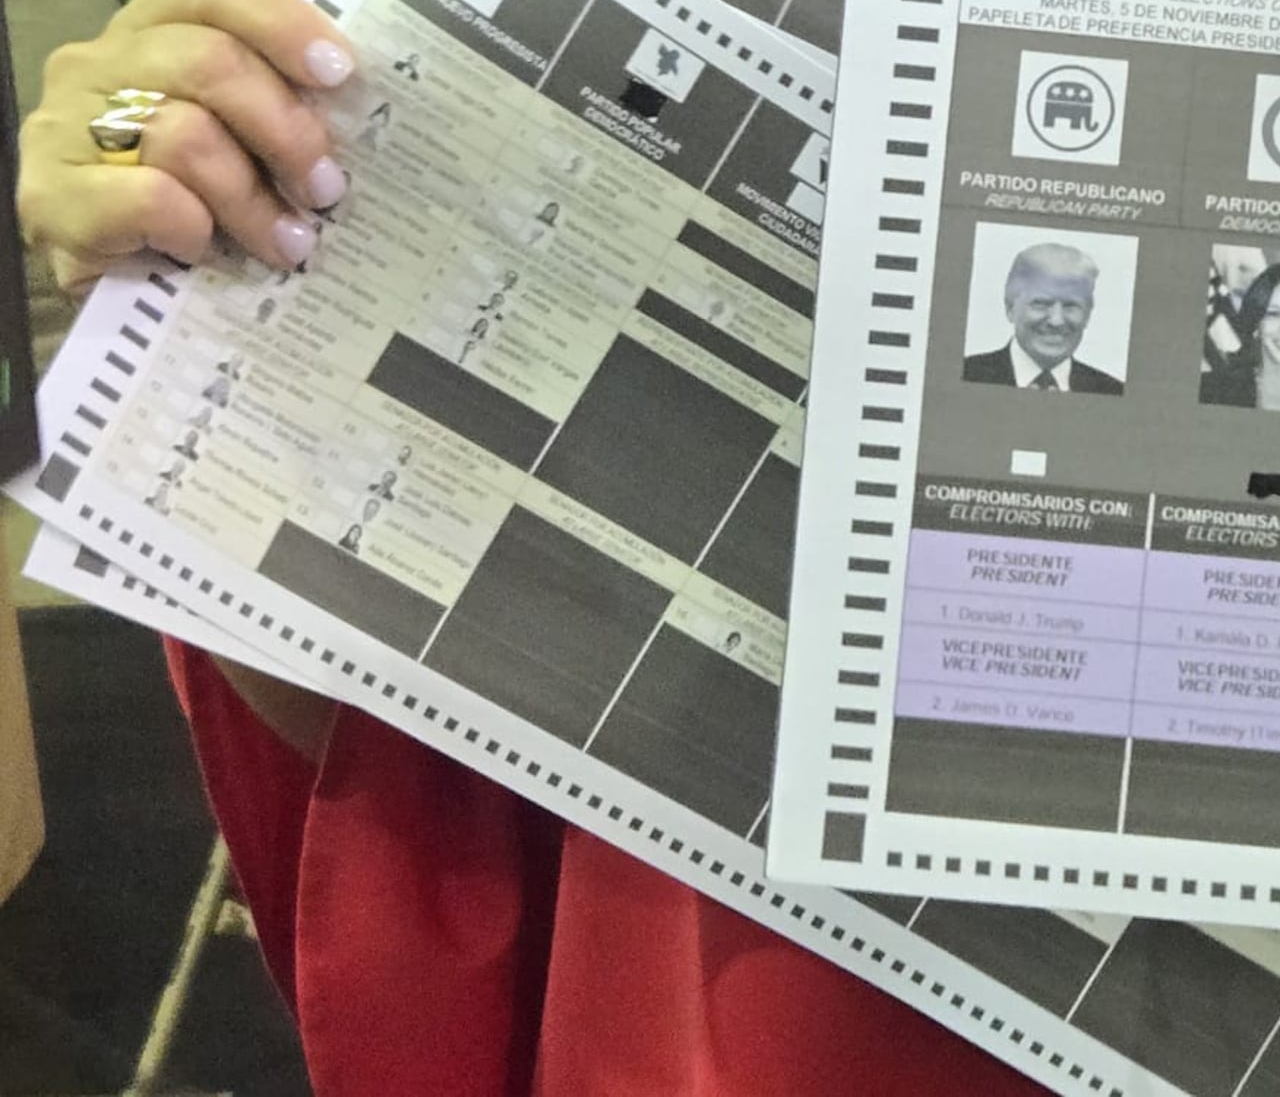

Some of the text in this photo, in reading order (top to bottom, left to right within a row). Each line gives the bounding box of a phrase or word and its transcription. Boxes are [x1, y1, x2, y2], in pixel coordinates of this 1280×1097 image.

[969, 7, 1057, 28] PAPELETA
[1059, 16, 1080, 31] DE
[1086, 19, 1207, 43] PREFERENCIA
[1120, 3, 1128, 16] 5
[1134, 4, 1157, 19] DE
[1162, 7, 1263, 30] NOVIEMBRE
[578, 84, 630, 122] PARTIDO
[626, 114, 683, 155] POPULAR
[582, 104, 666, 161] DEMOCRÁTICO
[960, 171, 1165, 205] PARTIDO REPUBLICANO
[734, 181, 807, 231] MOVIMIENTO
[985, 193, 1142, 220] REPUBLICAN PARTY
[925, 485, 1132, 518] COMPROMISARIOS CON:
[950, 504, 1041, 526] ELECTORS
[1186, 526, 1278, 548] ELECTORS
[967, 548, 1074, 571] PRESIDENTE
[971, 566, 1069, 587] PRESIDENT
[959, 606, 1012, 626] Donald
[1036, 613, 1084, 632] Trump
[1195, 629, 1250, 648] Kamala
[942, 639, 1088, 666] VICEPRESIDENTE
[942, 657, 1083, 681] VICE PRESIDENT
[1178, 678, 1216, 694] VICE
